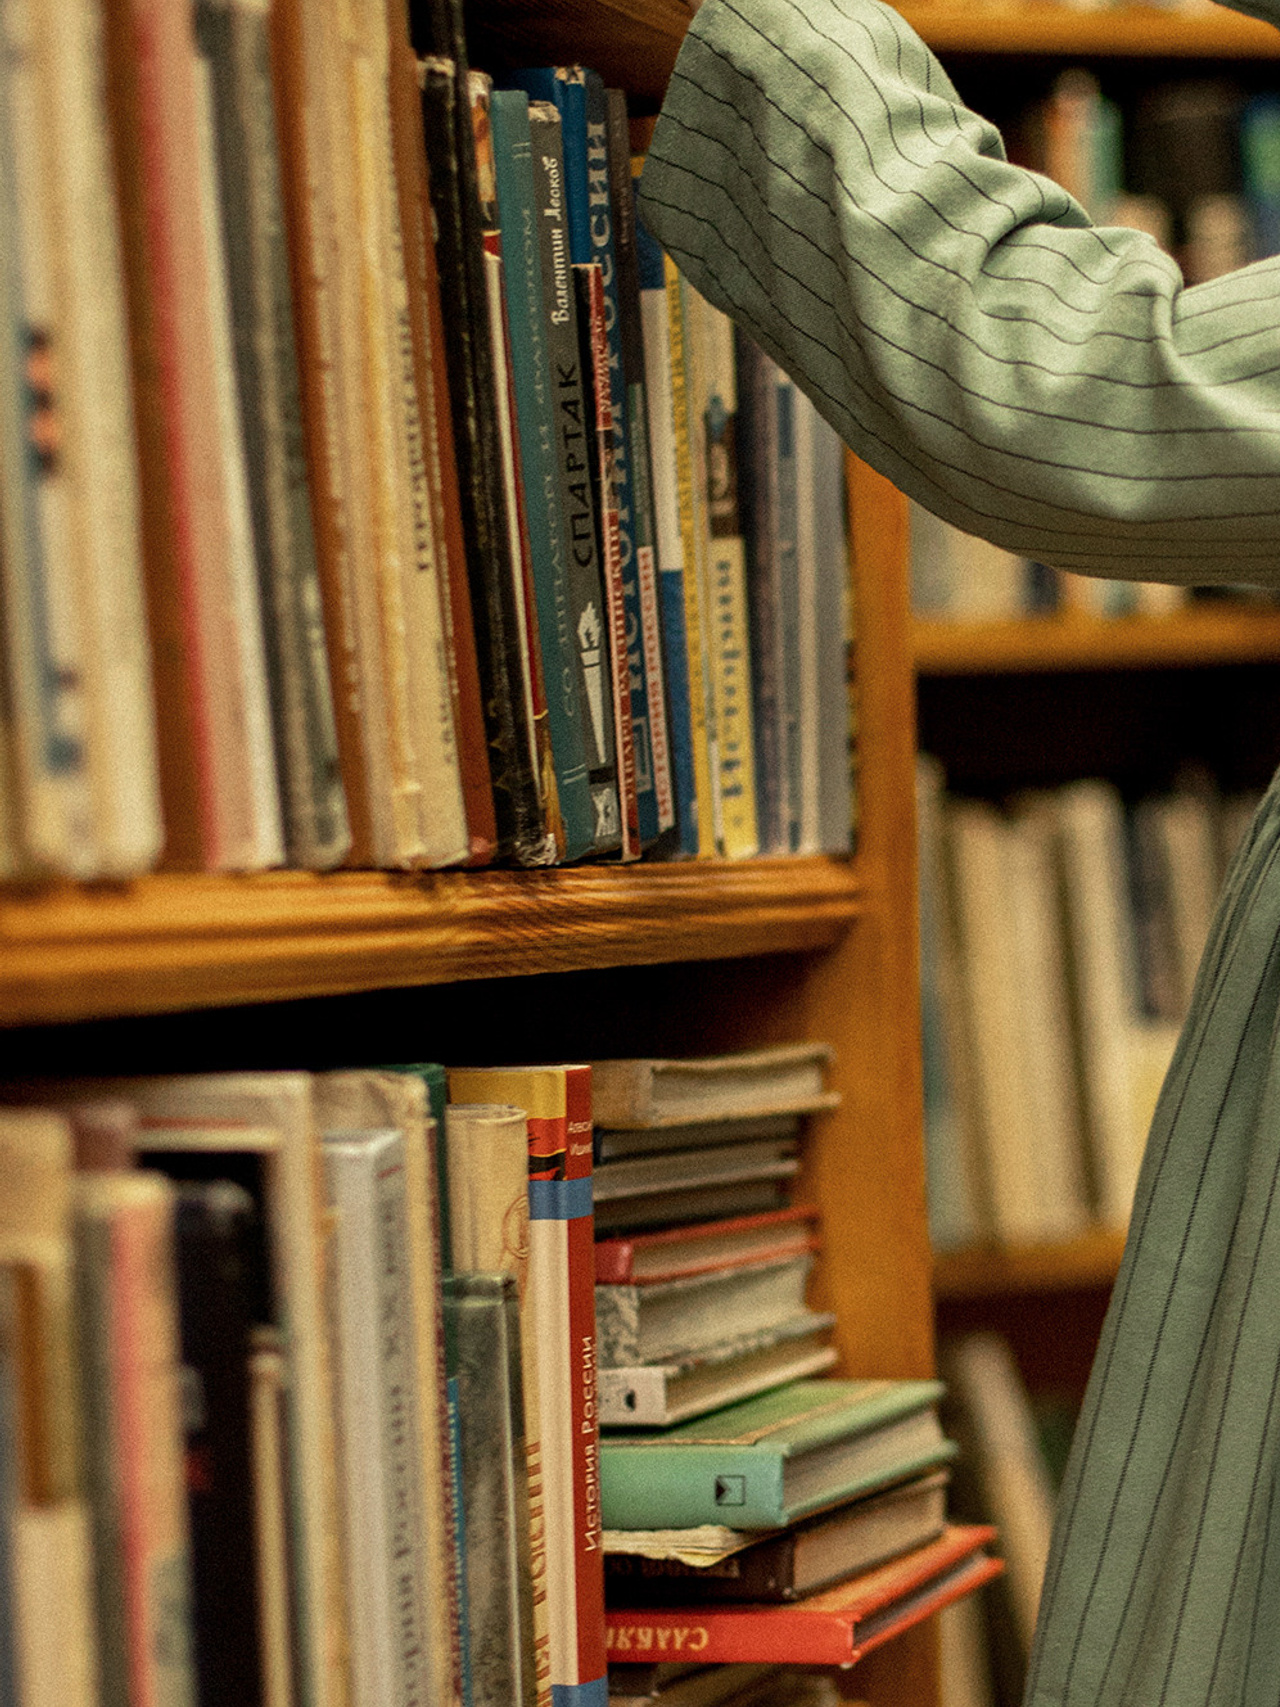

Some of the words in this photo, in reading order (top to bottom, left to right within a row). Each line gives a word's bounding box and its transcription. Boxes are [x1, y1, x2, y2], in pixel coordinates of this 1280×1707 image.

[550, 228, 572, 326] Валентин
[557, 363, 592, 568] СПАРТАК
[562, 666, 575, 717] СО
